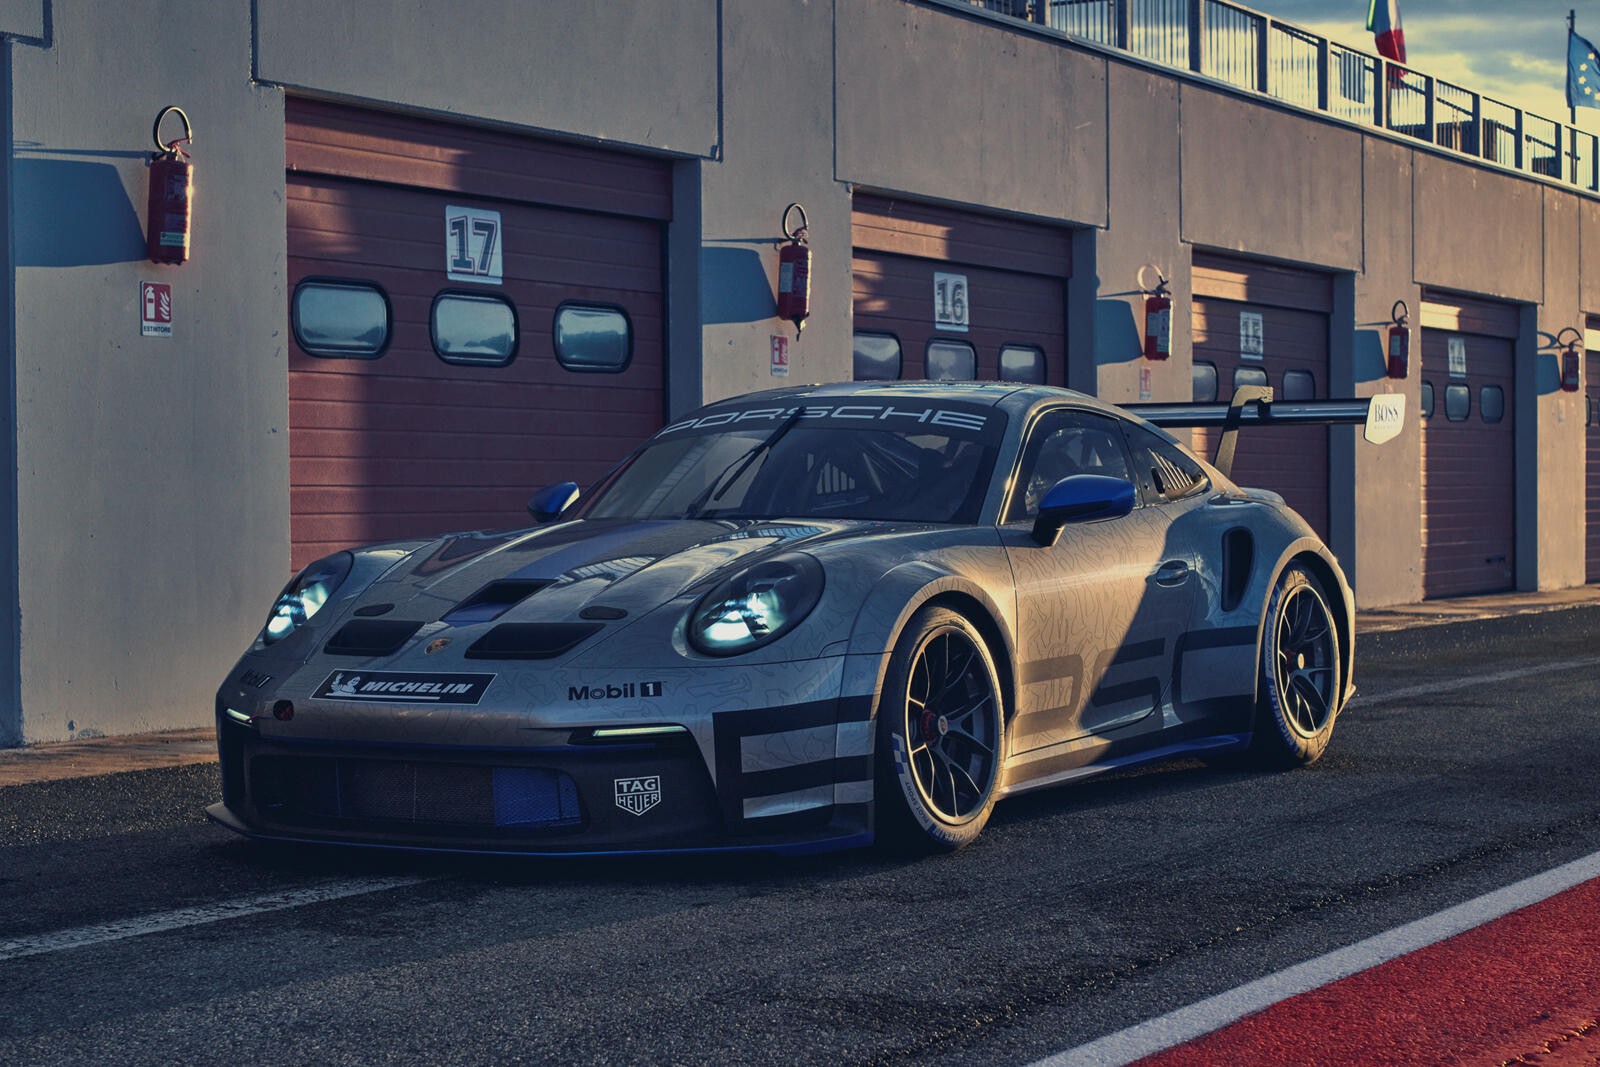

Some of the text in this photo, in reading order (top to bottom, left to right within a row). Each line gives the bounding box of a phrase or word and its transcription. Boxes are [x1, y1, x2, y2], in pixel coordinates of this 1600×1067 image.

[450, 216, 497, 276] 17
[936, 279, 966, 325] 16
[1374, 404, 1399, 422] BOSS
[654, 406, 987, 440] PORSCHE
[360, 681, 474, 694] MICHELIN
[568, 682, 635, 700] Mobil
[618, 779, 656, 792] TAG
[618, 793, 658, 812] HEUER
